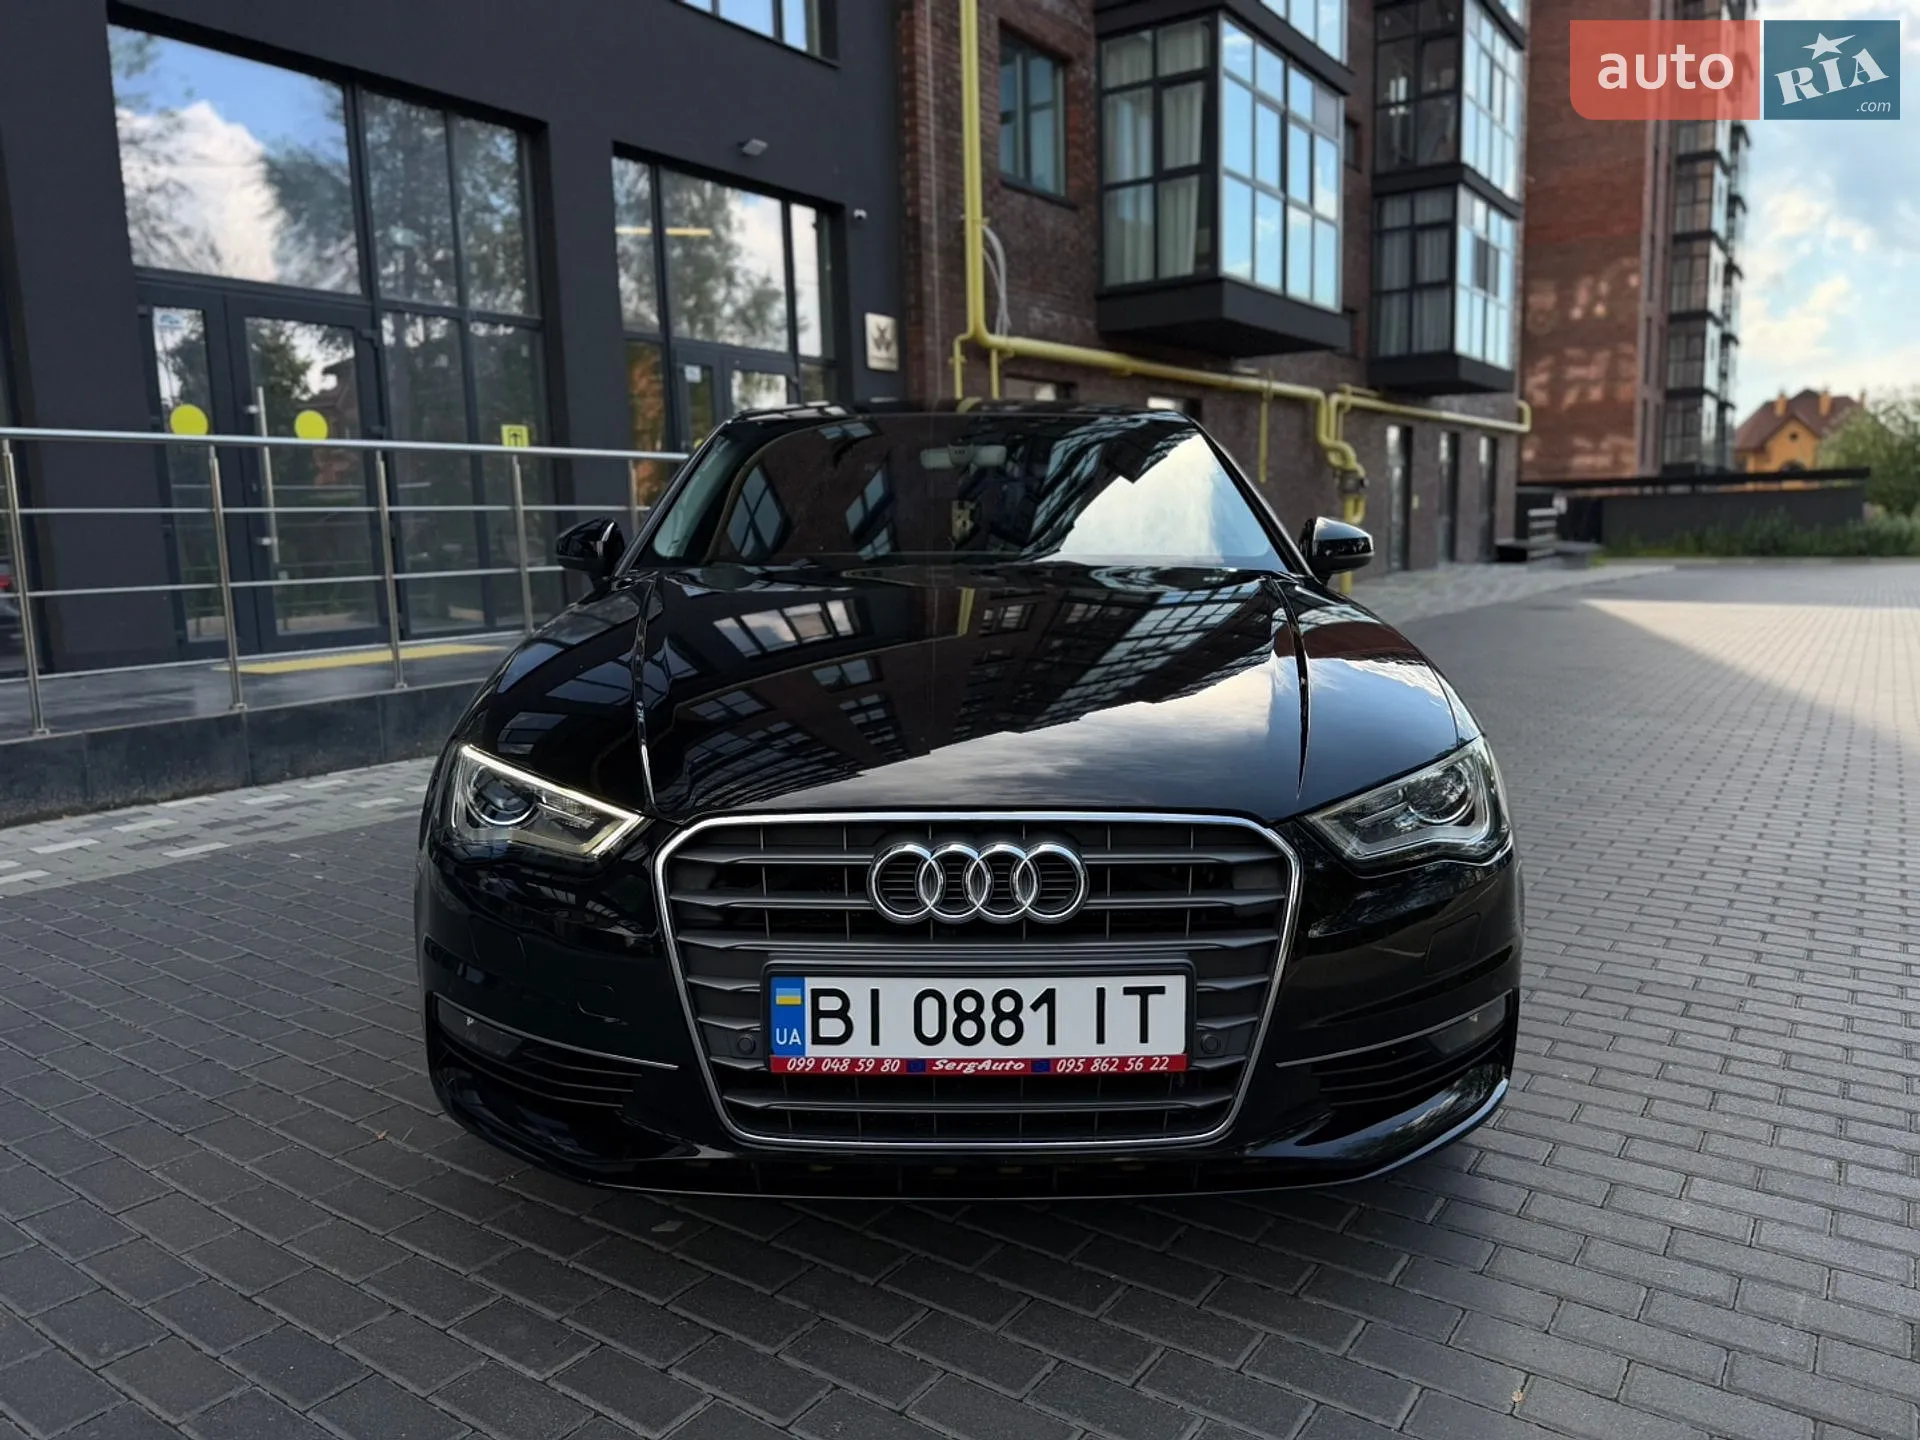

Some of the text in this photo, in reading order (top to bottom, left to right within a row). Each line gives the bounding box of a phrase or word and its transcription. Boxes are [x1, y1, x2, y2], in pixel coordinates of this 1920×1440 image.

[810, 985, 1167, 1047] BI 0881 IT
[775, 1028, 802, 1046] UA
[786, 1056, 1169, 1074] 099 048 59 80 SergAuto 095 862 56 22
